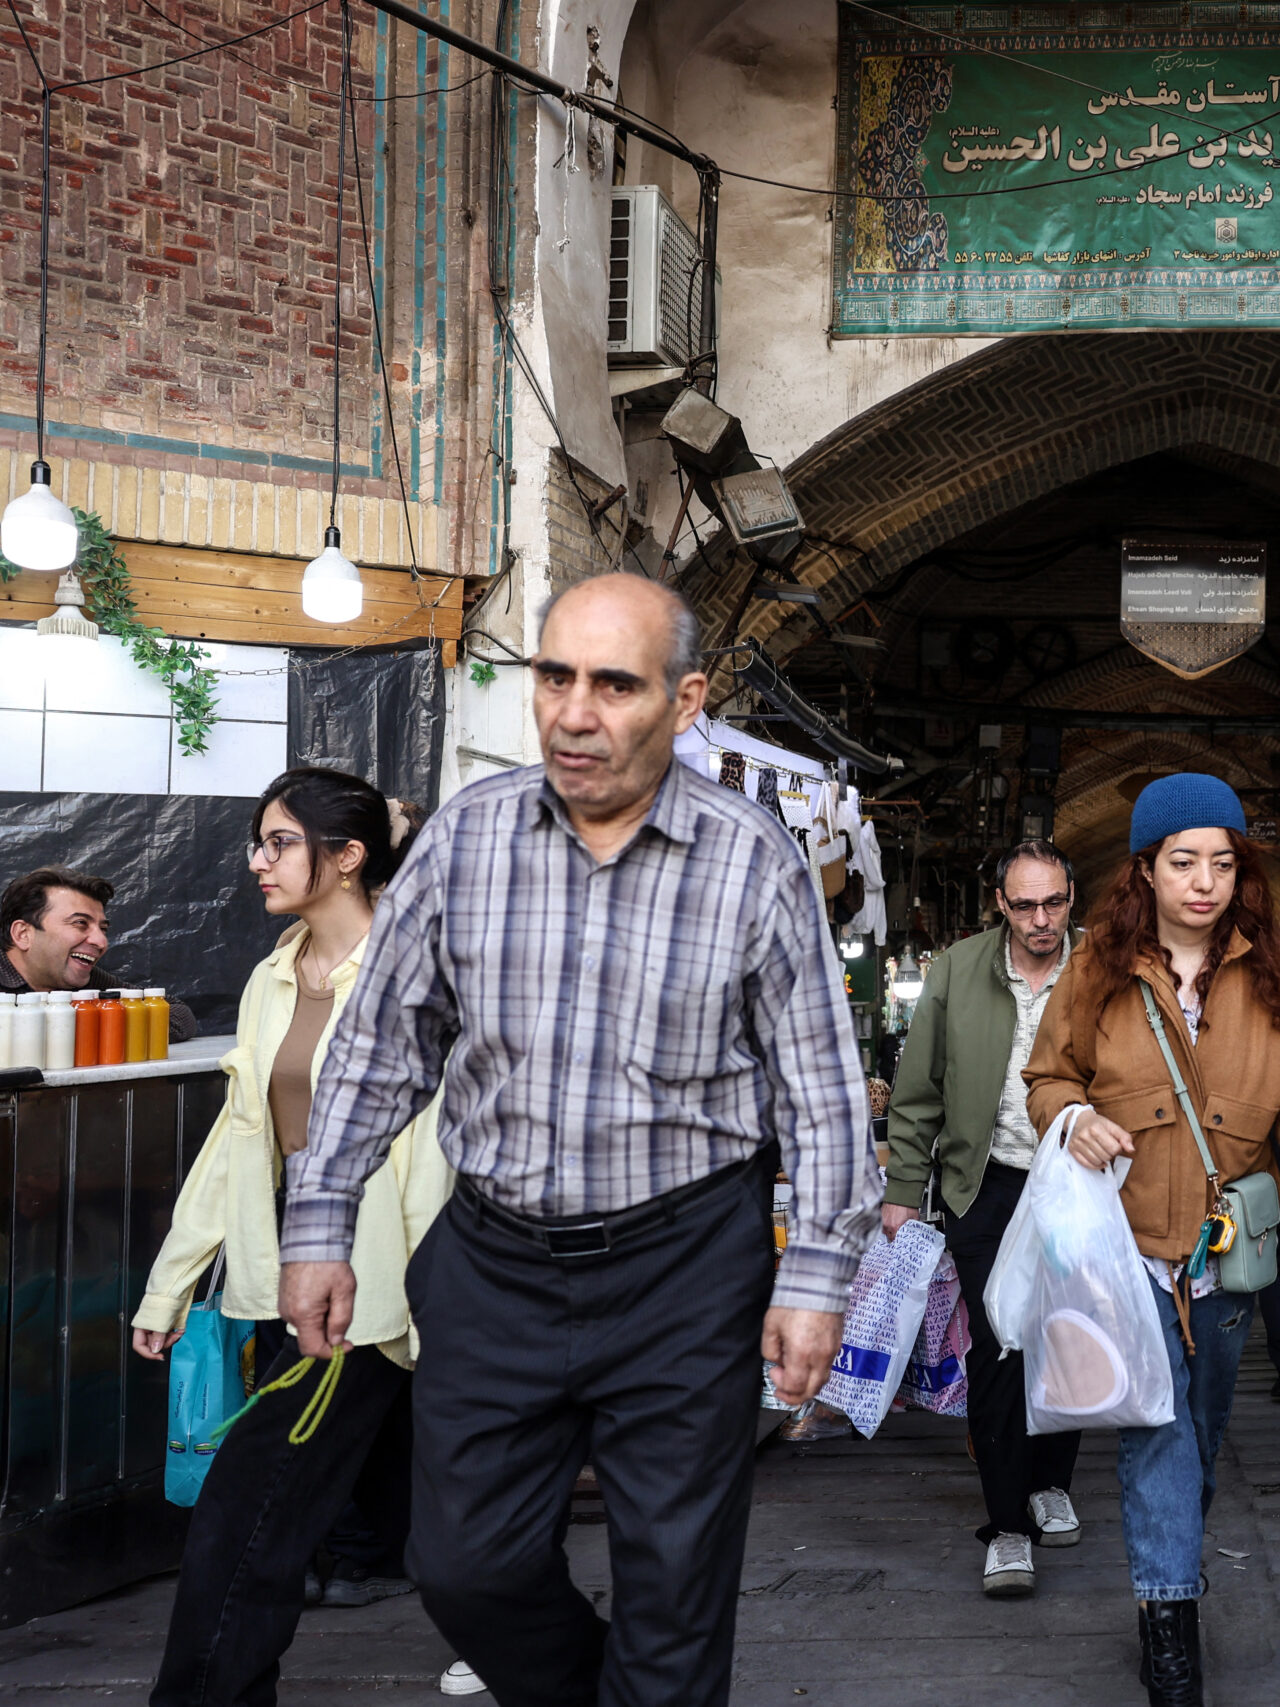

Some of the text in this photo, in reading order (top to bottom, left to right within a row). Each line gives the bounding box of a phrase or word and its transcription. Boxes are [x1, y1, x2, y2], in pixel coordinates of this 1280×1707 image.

[1087, 81, 1182, 115] مقدس
[941, 124, 1060, 173] الحسین
[1067, 133, 1107, 172] بن
[1114, 122, 1181, 171] علی
[1187, 131, 1228, 169] بن
[1135, 184, 1182, 209] سجاد
[1185, 183, 1221, 210] امام
[1226, 181, 1274, 209] فرزند
[1014, 252, 1033, 265] تلفن
[1071, 250, 1090, 265] بازار
[1091, 249, 1117, 263] انتهای
[1123, 247, 1151, 262] آدرس
[1221, 250, 1235, 261] امور
[1241, 248, 1261, 261] اوقاف
[1261, 249, 1280, 260] اداره
